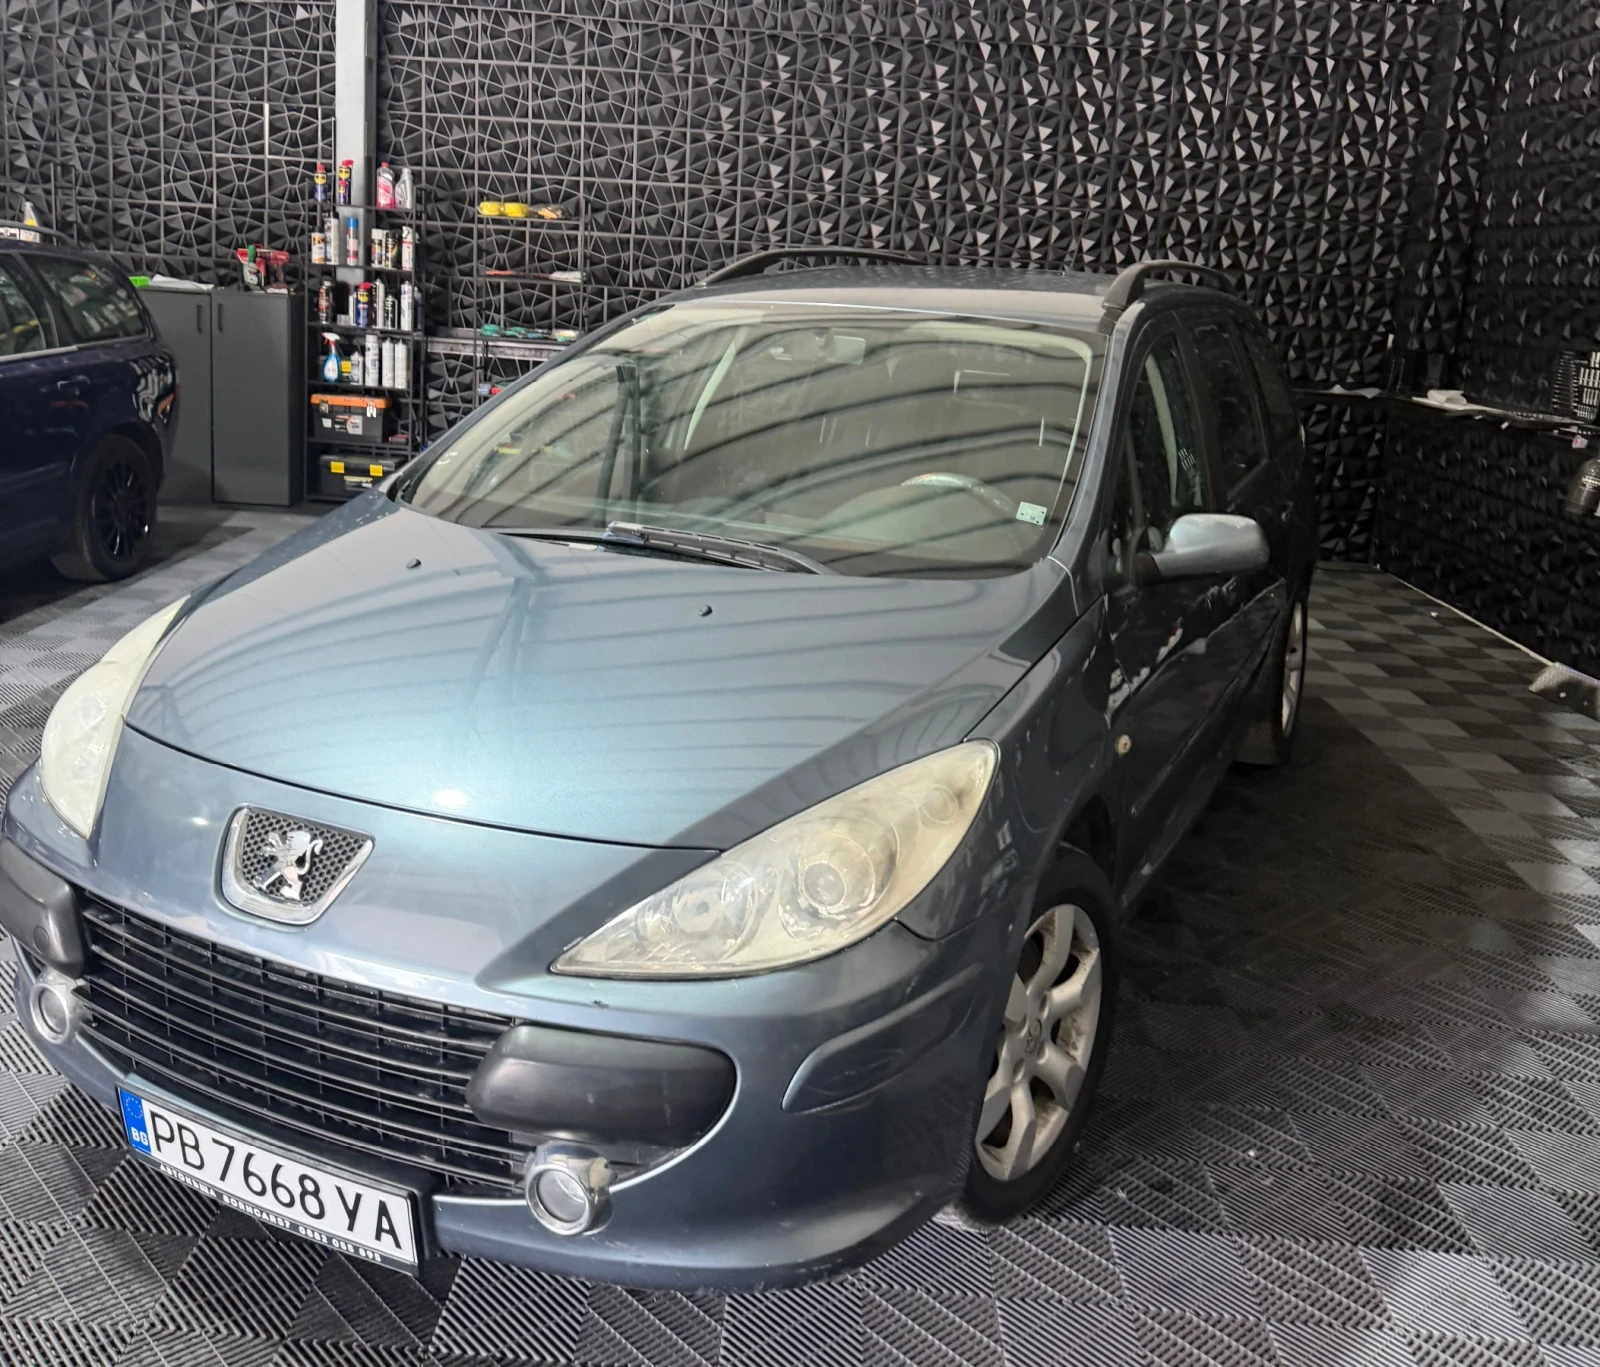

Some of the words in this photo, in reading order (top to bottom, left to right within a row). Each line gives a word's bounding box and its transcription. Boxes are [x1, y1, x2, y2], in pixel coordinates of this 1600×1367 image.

[131, 1127, 149, 1146] BG
[149, 1109, 205, 1171] PB
[212, 1137, 325, 1220] 7668
[335, 1183, 403, 1251] YA
